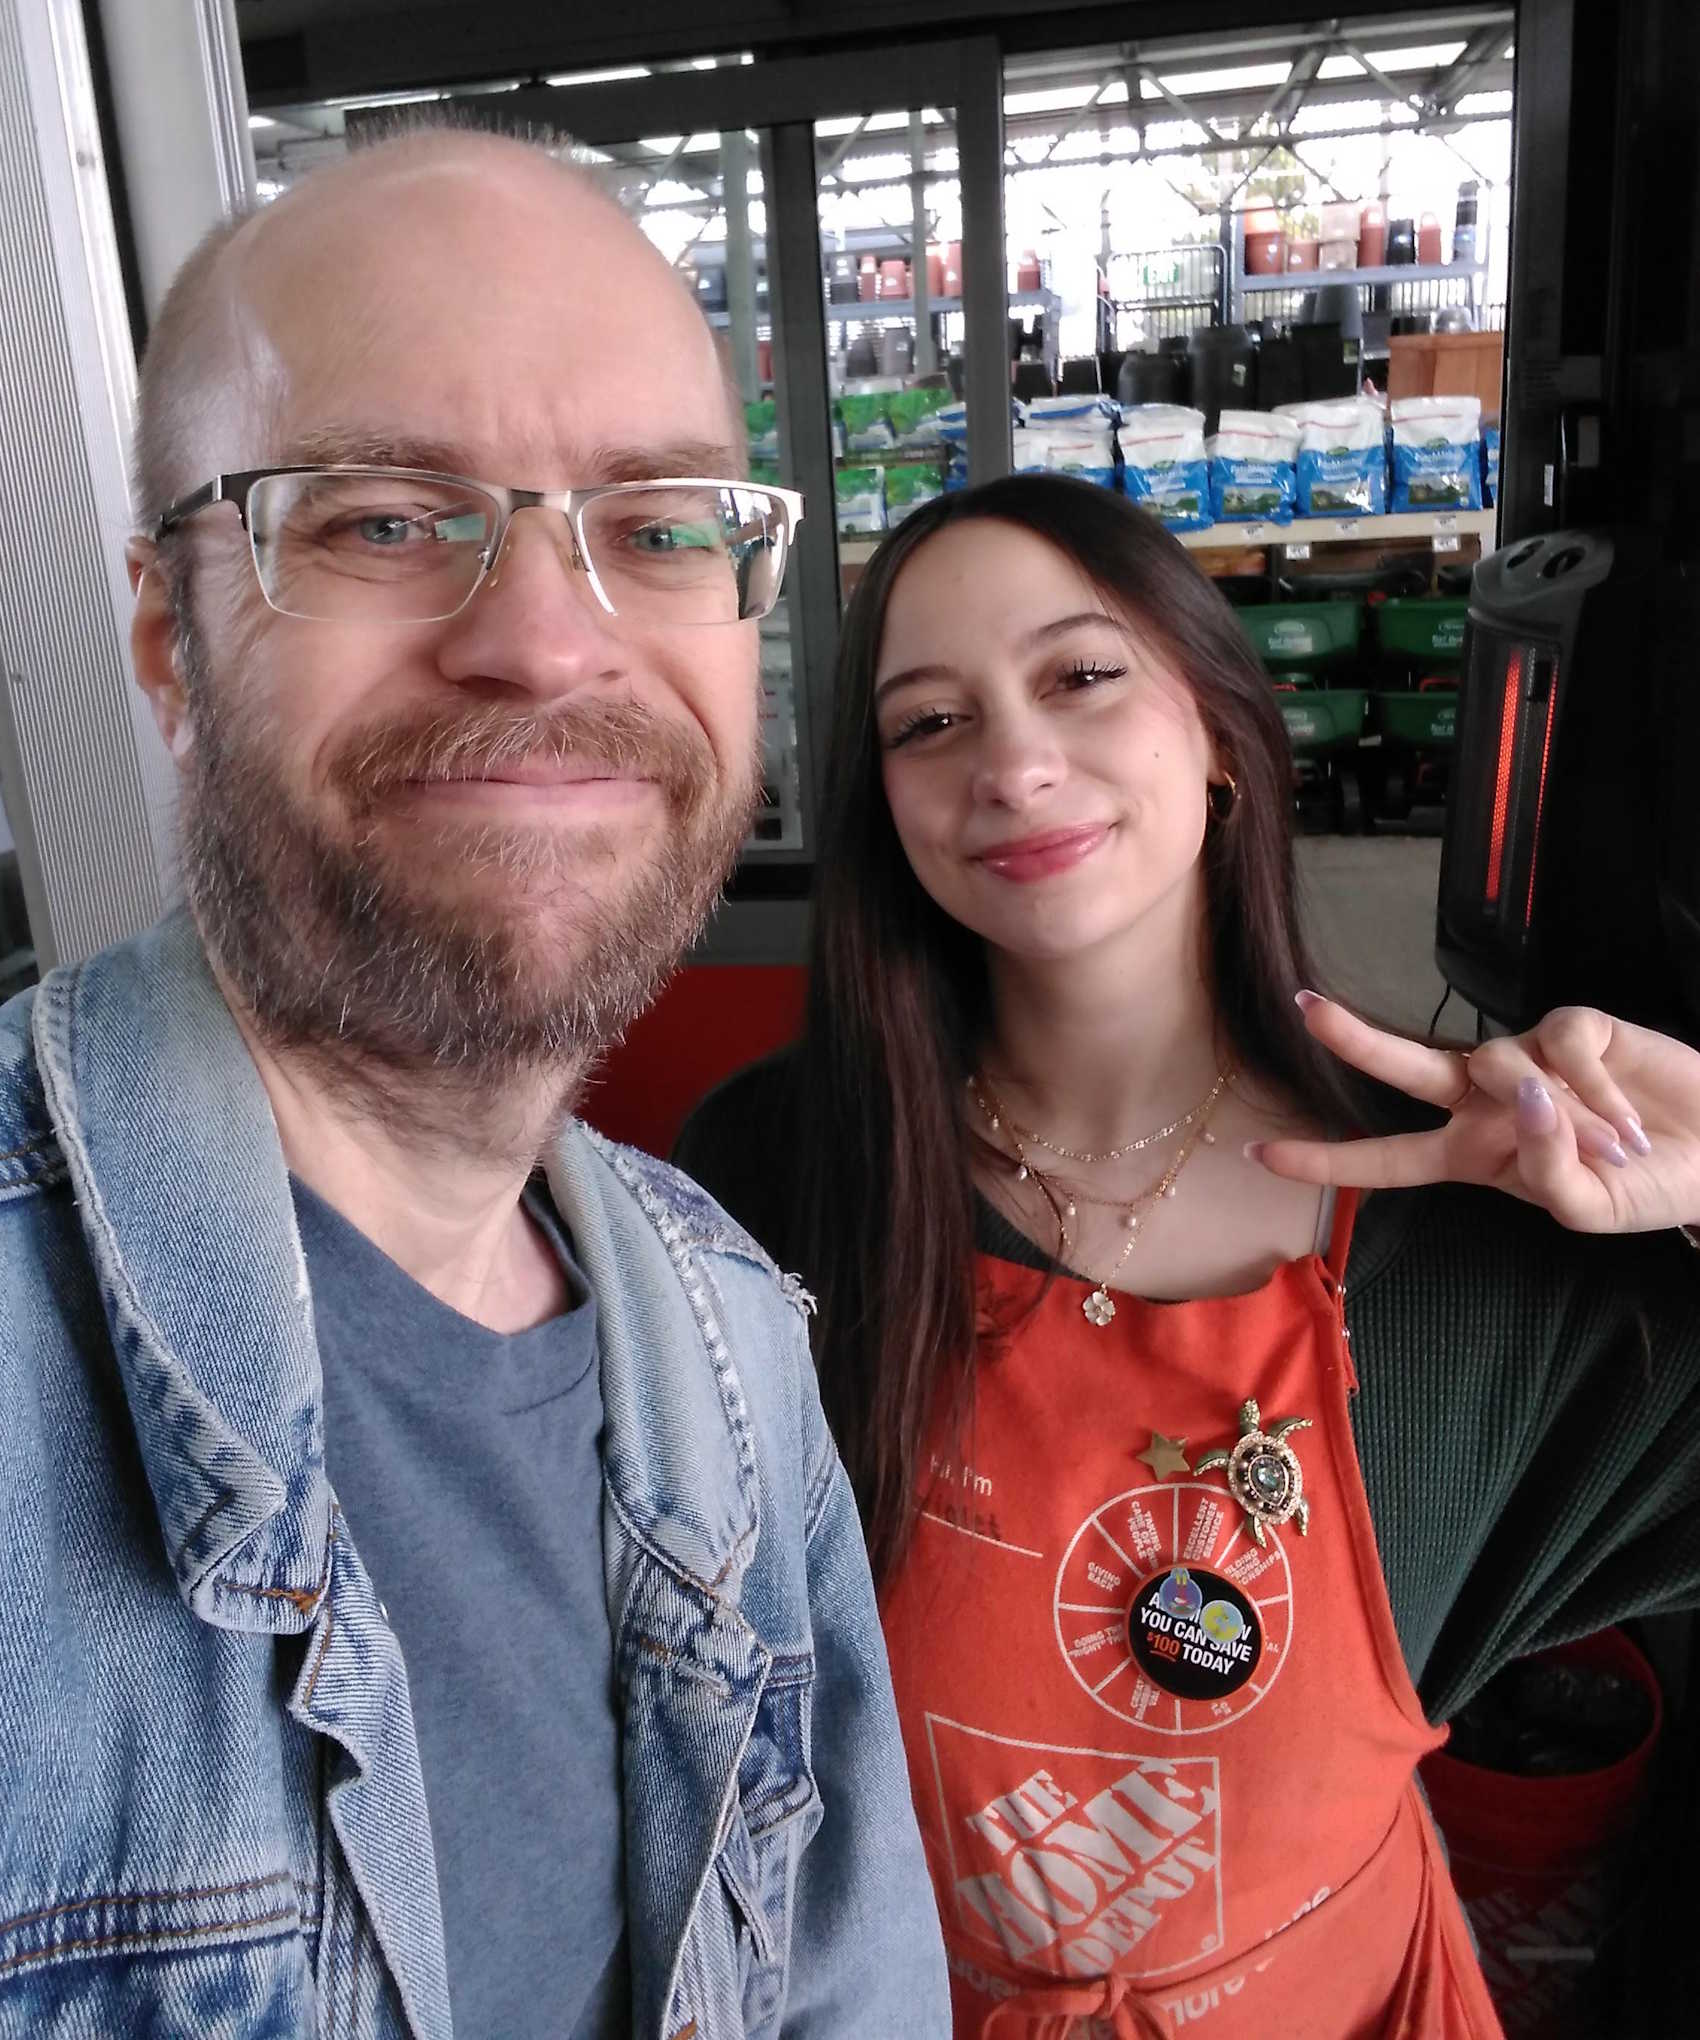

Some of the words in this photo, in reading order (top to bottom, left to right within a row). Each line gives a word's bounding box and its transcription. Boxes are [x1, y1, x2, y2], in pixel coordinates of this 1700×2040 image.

[962, 1466, 993, 1496] I'm
[1183, 1497, 1209, 1559] EXCELLENT
[1191, 1502, 1218, 1560] CUSTOMER
[1203, 1511, 1224, 1558] SERVICE
[1088, 1561, 1121, 1586] GIVING
[1088, 1571, 1114, 1592] BACK
[1140, 1606, 1173, 1632] YOU
[1173, 1620, 1207, 1646] CAN
[1145, 1631, 1181, 1656] $100
[1182, 1642, 1235, 1675] TODAY
[965, 1769, 1079, 1856] THE
[954, 1760, 1219, 1958] HOME
[1060, 1834, 1218, 1978] DEPOT
